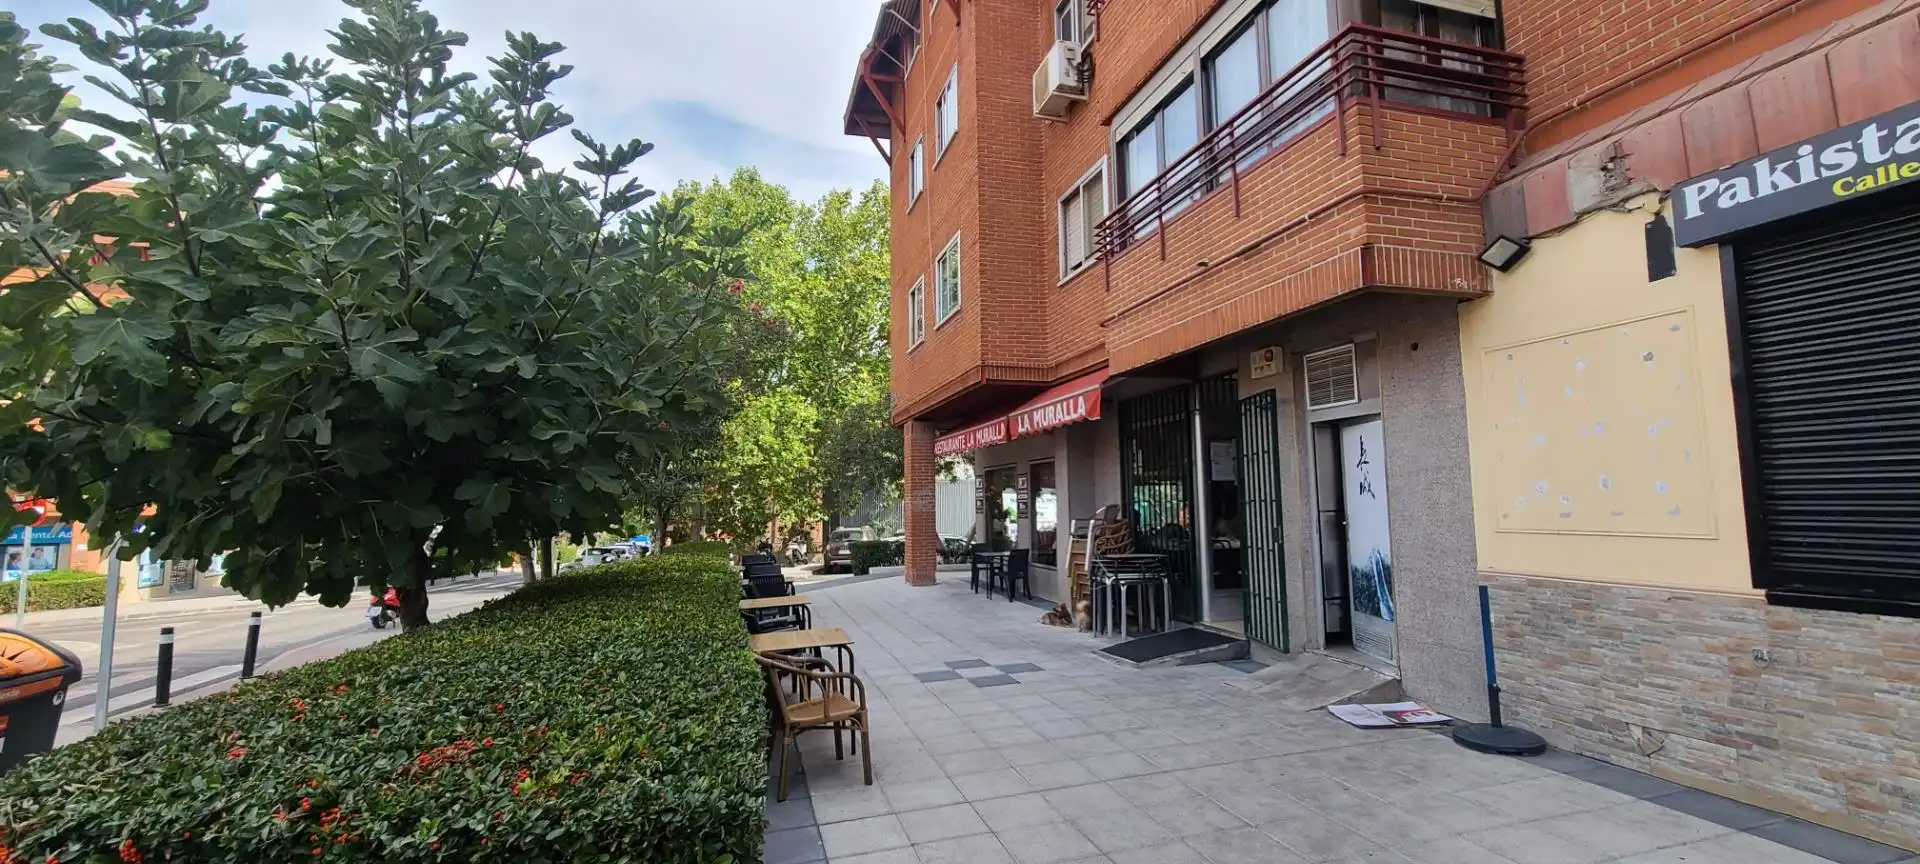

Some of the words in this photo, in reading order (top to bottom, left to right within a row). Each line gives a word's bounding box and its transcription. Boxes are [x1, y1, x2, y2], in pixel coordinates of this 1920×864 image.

[1832, 161, 1920, 197] Calle
[1017, 415, 1031, 433] LA
[1033, 396, 1086, 429] MURALLA
[967, 431, 975, 447] LA
[976, 422, 1006, 445] MURALLA
